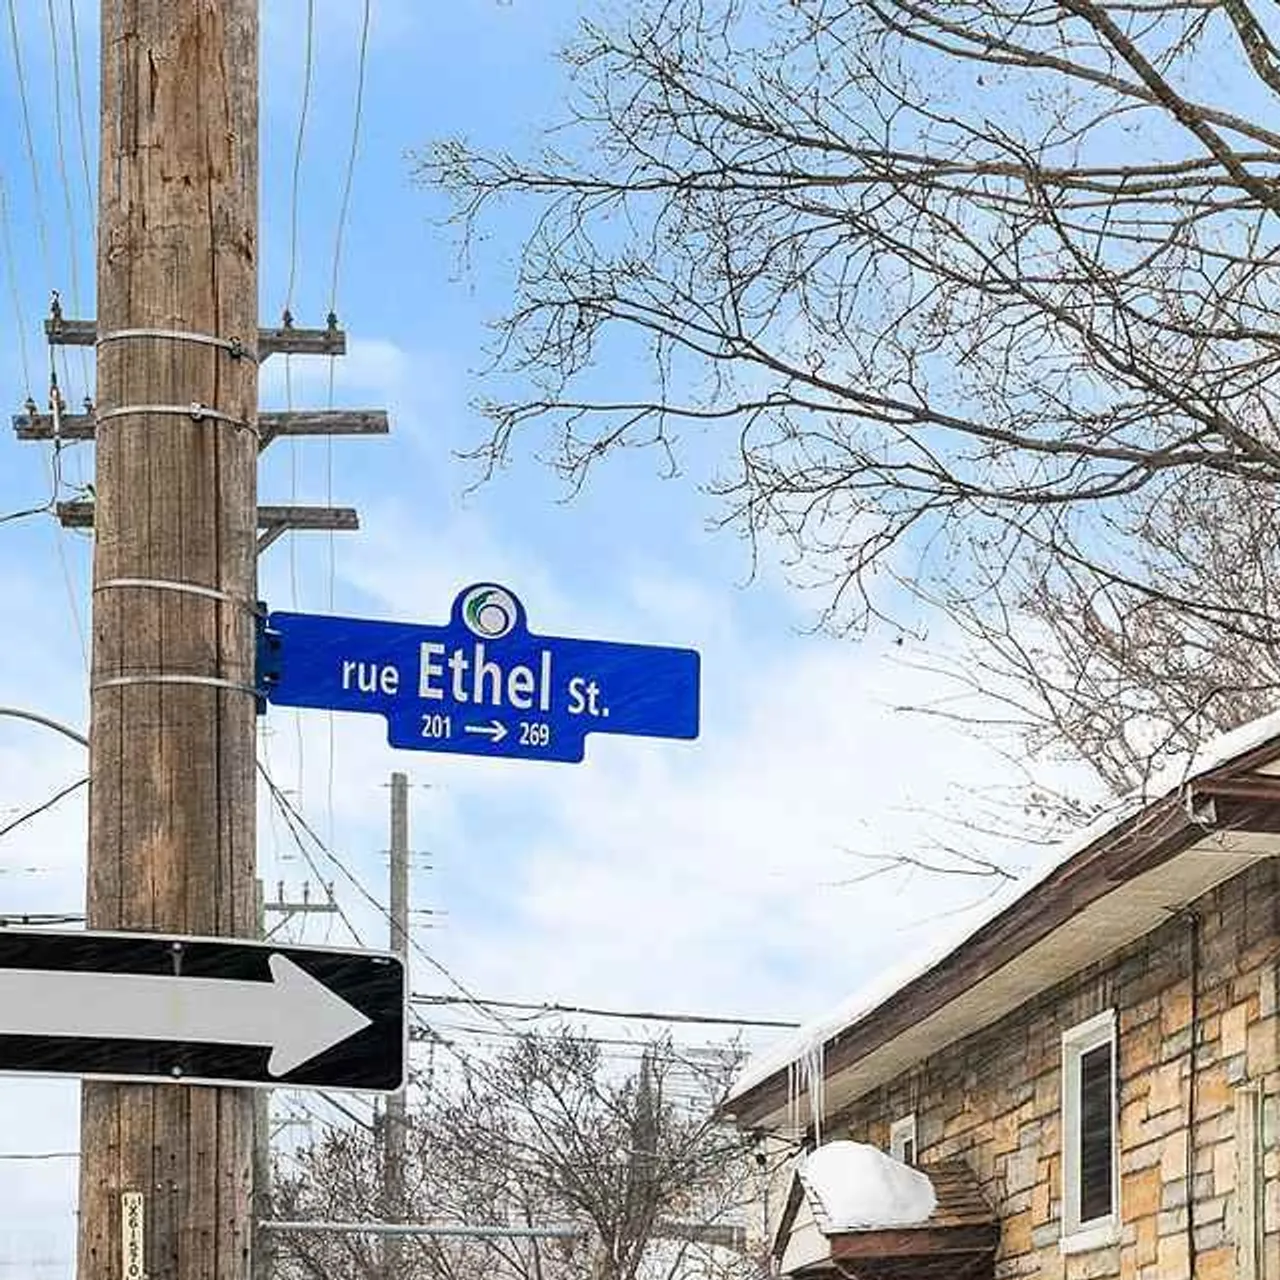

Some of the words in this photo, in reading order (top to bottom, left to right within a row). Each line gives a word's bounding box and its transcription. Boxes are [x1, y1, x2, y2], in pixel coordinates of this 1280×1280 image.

[342, 660, 399, 695] rue
[419, 641, 551, 711] Ethel
[567, 677, 609, 717] St.
[421, 714, 451, 739] 201
[520, 722, 549, 747] 269
